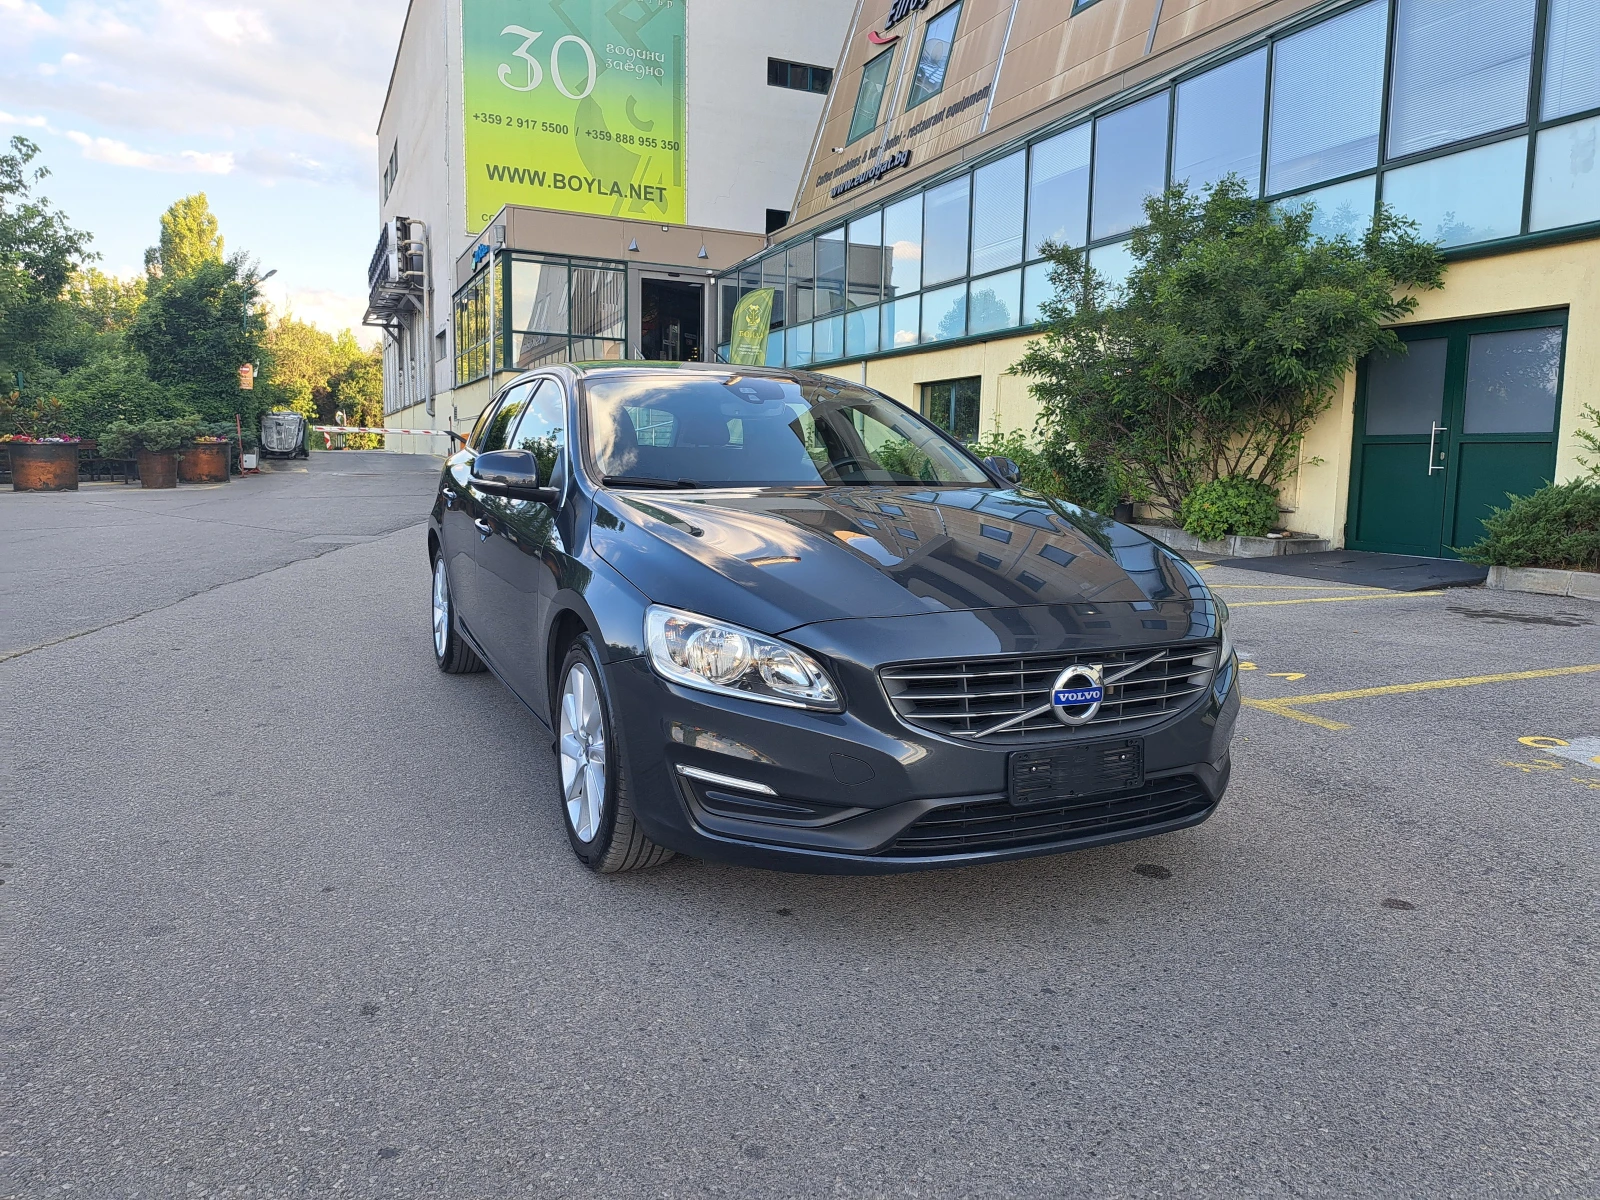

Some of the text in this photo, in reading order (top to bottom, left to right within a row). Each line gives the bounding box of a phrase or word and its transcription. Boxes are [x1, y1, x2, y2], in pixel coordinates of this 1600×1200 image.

[497, 24, 597, 100] 30
[606, 44, 665, 63] години
[907, 107, 947, 139] restaurant
[945, 83, 992, 119] equipment
[473, 112, 502, 125] +359
[506, 116, 513, 127] 2
[516, 117, 538, 130] 917
[541, 121, 569, 135] 5500
[585, 129, 612, 141] +359
[615, 132, 635, 145] 888
[638, 136, 657, 148] 955
[660, 139, 680, 152] 350
[485, 163, 667, 203] WWW.BOYLA.NET
[830, 149, 911, 198] www.eurogat.bg
[1057, 690, 1100, 702] VOLVO
